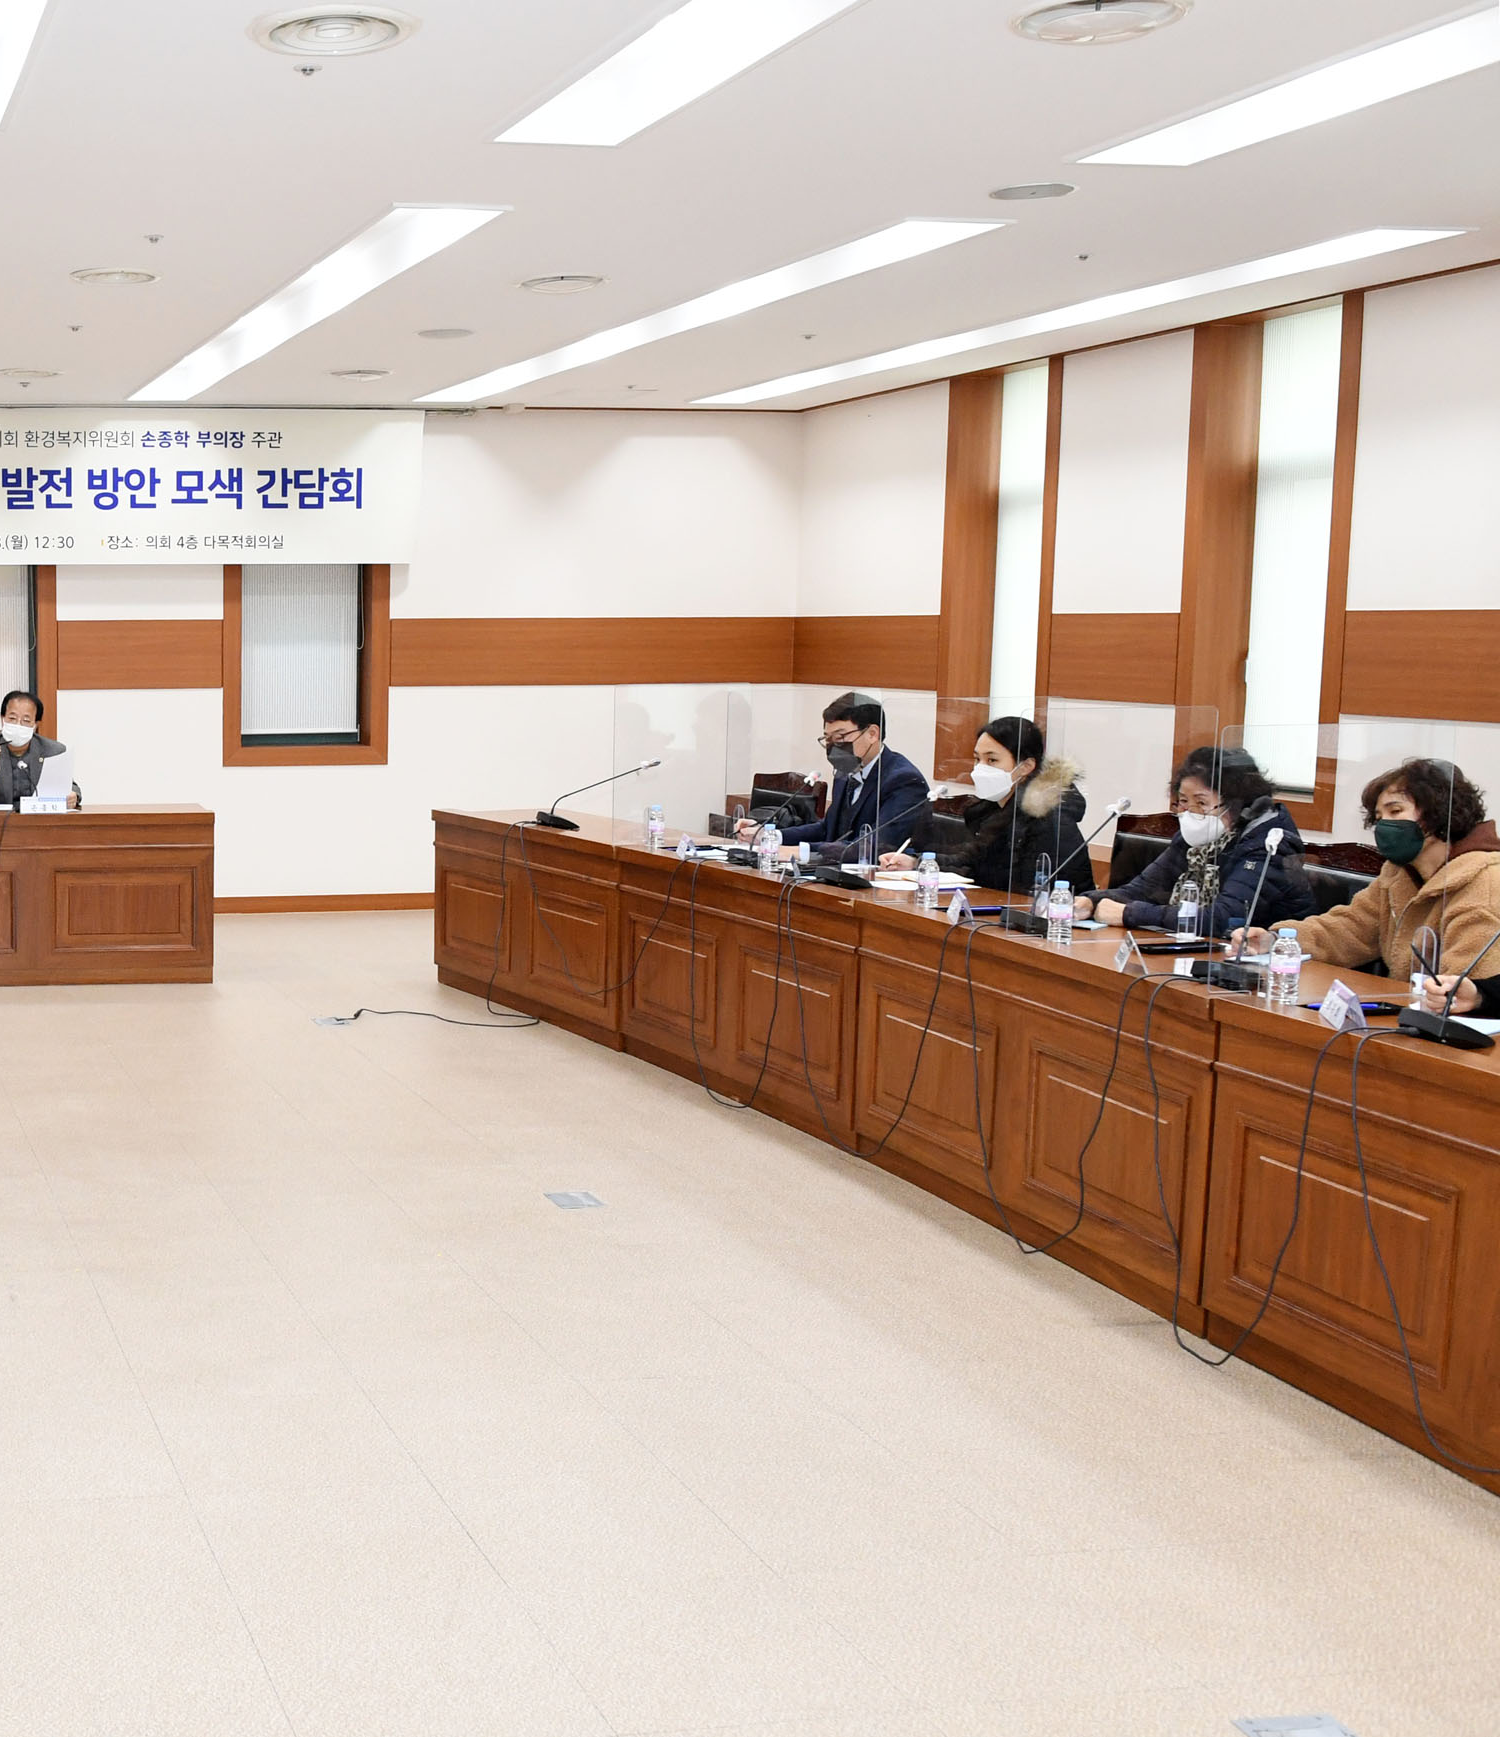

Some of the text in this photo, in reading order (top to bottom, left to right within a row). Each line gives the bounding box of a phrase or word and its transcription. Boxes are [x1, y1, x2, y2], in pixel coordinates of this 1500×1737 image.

[24, 429, 135, 449] 환경복지위원회
[140, 430, 191, 449] 손종학
[195, 430, 246, 449] 부의장
[250, 431, 284, 449] 주관
[1, 466, 73, 510] 발전
[87, 467, 161, 511] 방안
[171, 467, 243, 510] 모색
[256, 467, 363, 510] 간담회
[34, 536, 75, 550] 12:30
[145, 535, 172, 551] 의회
[176, 535, 198, 551] 4층
[203, 535, 284, 551] 다목적회의실
